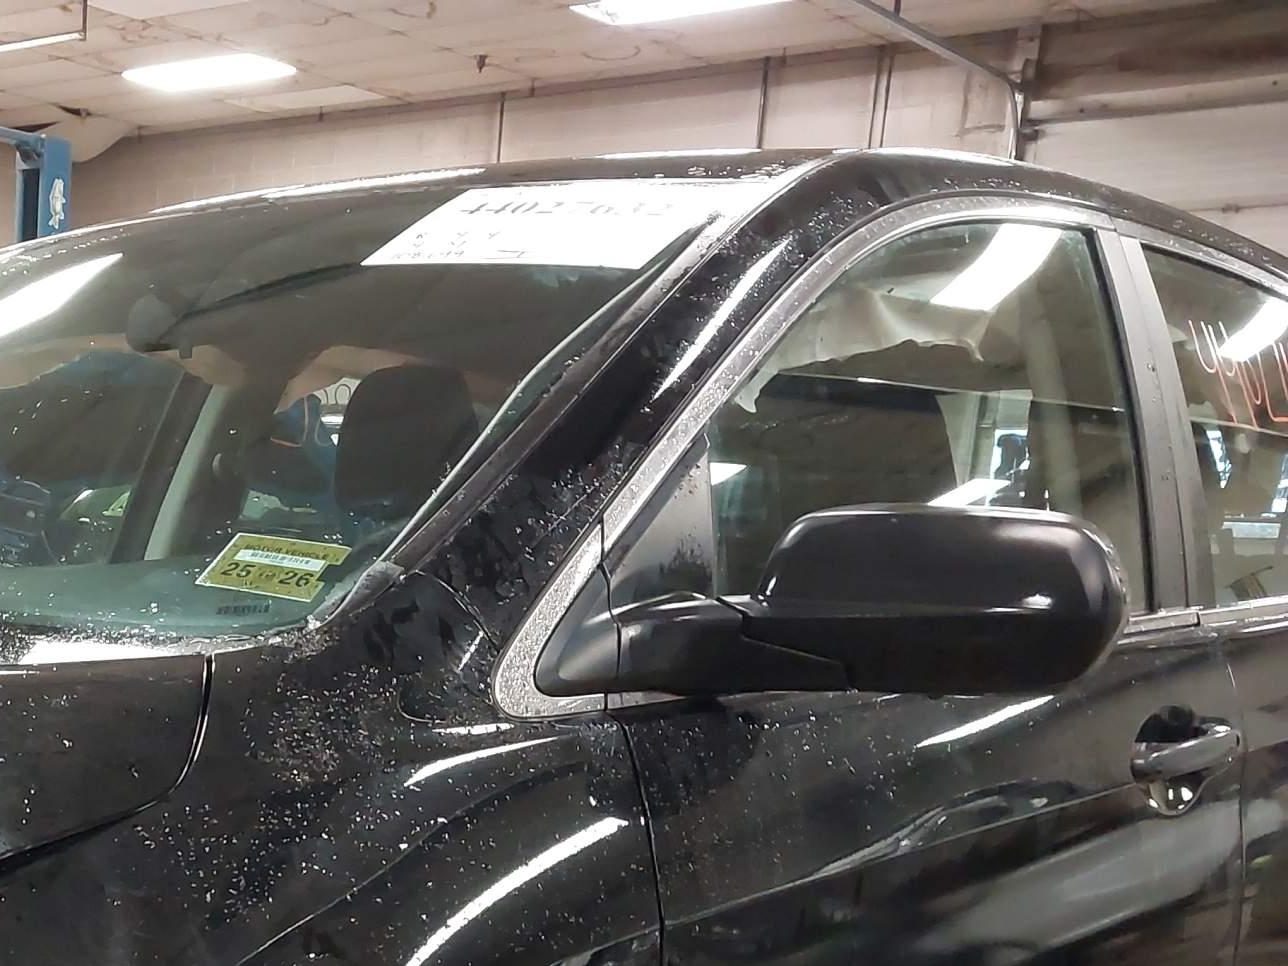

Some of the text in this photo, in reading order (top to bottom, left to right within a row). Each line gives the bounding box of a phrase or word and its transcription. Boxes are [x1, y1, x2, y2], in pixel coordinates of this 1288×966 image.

[244, 543, 283, 554] MOTOR
[284, 548, 329, 560] VEHICLE
[220, 561, 256, 579] 25
[278, 570, 314, 588] 26
